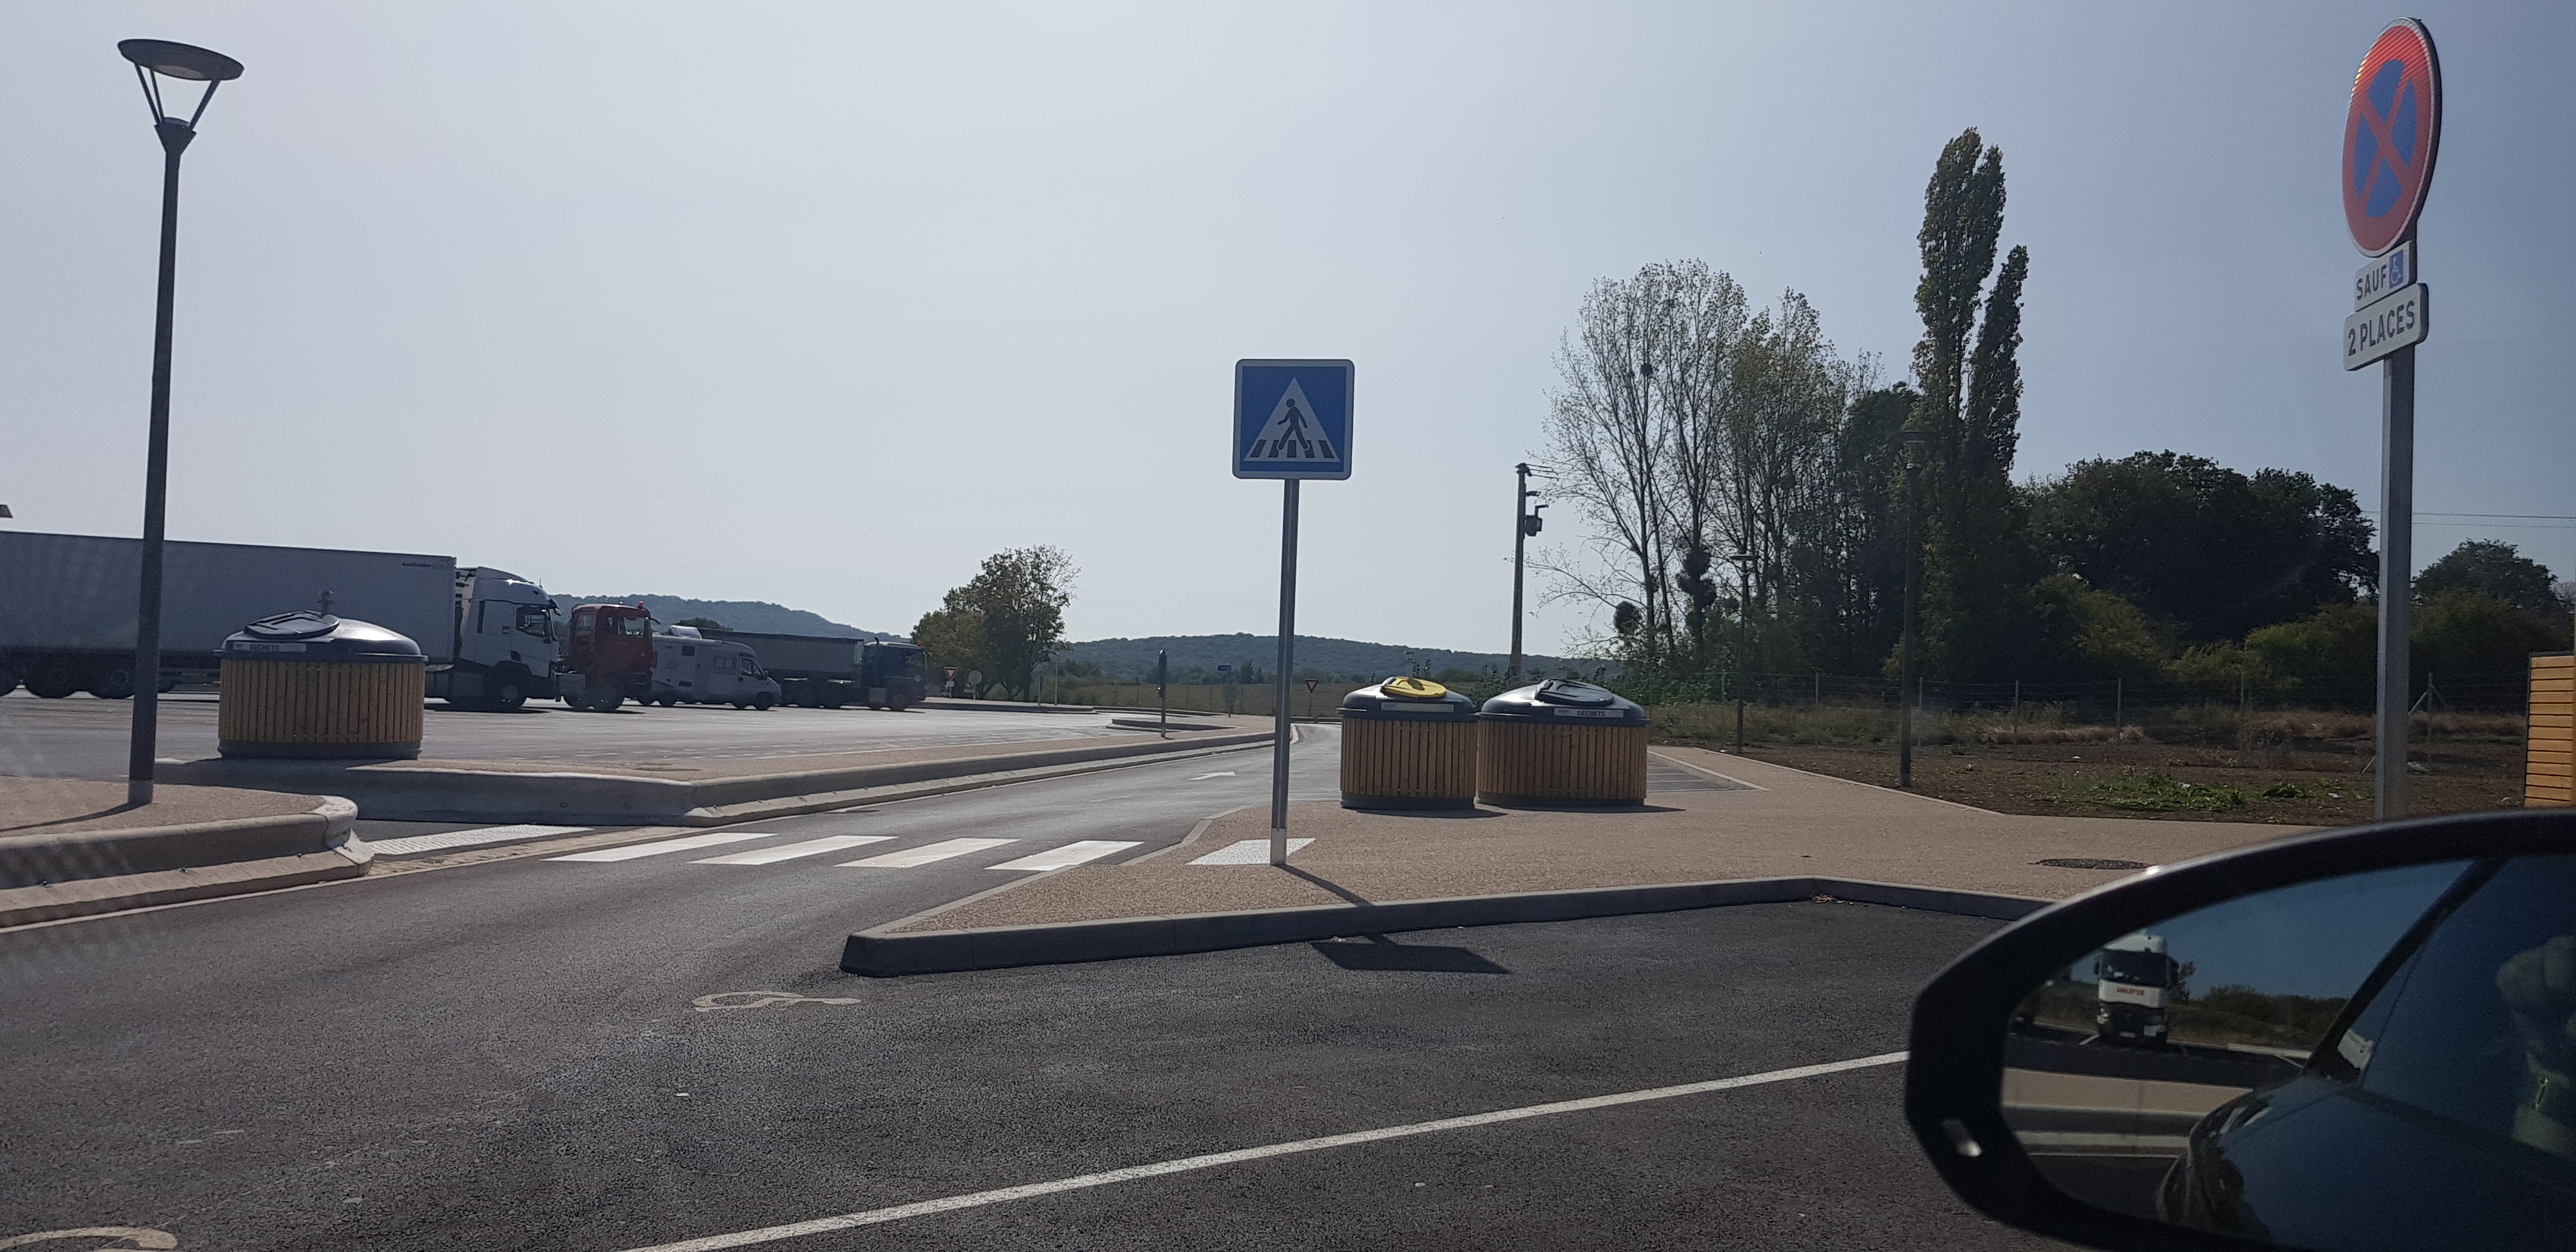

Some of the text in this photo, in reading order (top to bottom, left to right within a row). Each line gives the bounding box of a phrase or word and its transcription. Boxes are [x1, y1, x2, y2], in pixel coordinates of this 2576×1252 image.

[2356, 264, 2388, 300] SAUF
[2347, 300, 2416, 356] 2 PLACES
